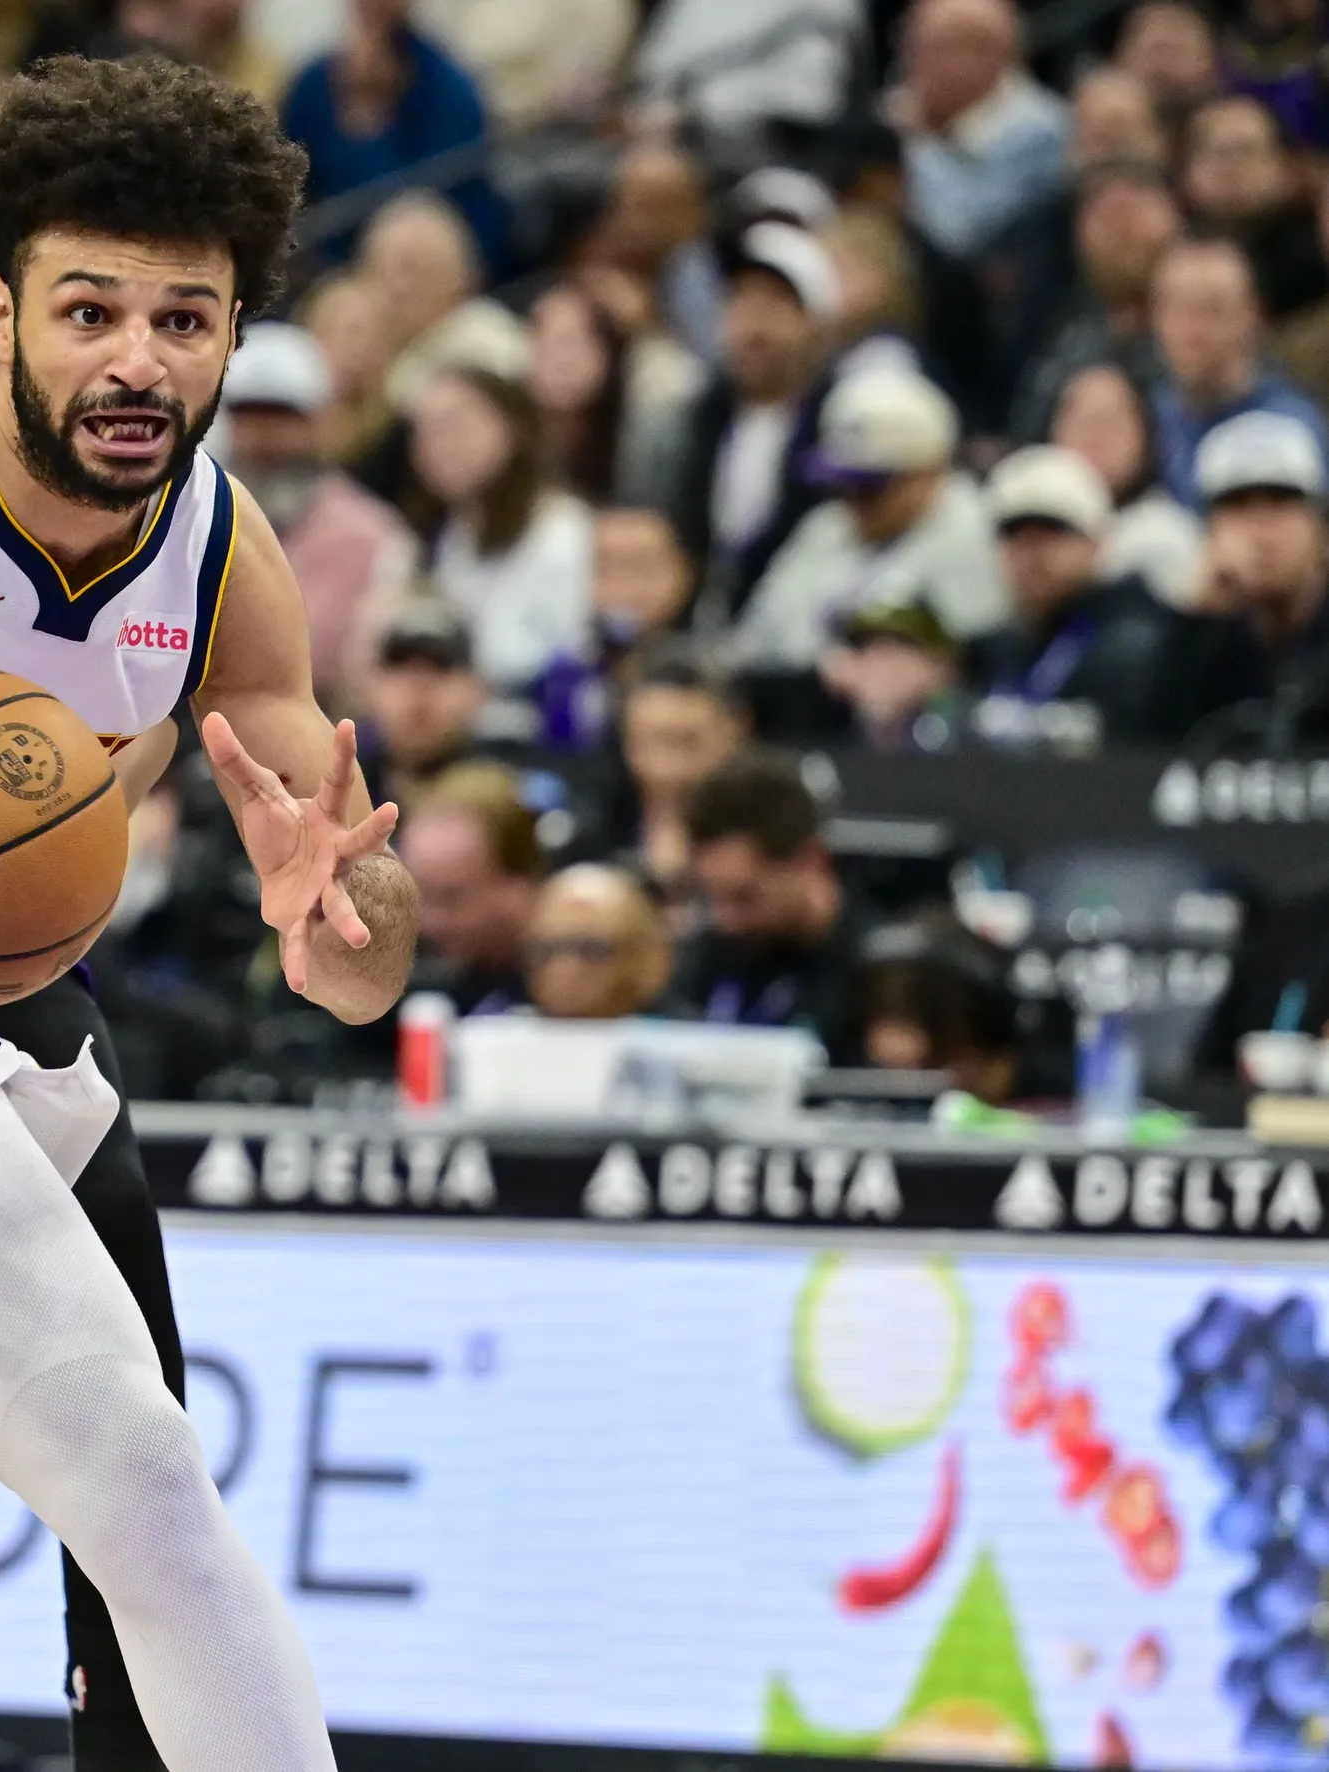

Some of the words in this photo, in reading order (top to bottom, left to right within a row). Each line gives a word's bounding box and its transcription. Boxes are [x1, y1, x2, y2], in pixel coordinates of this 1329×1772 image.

[261, 1130, 498, 1206] DELTA
[658, 1143, 904, 1221] DELTA
[1073, 1155, 1322, 1234] DELTA
